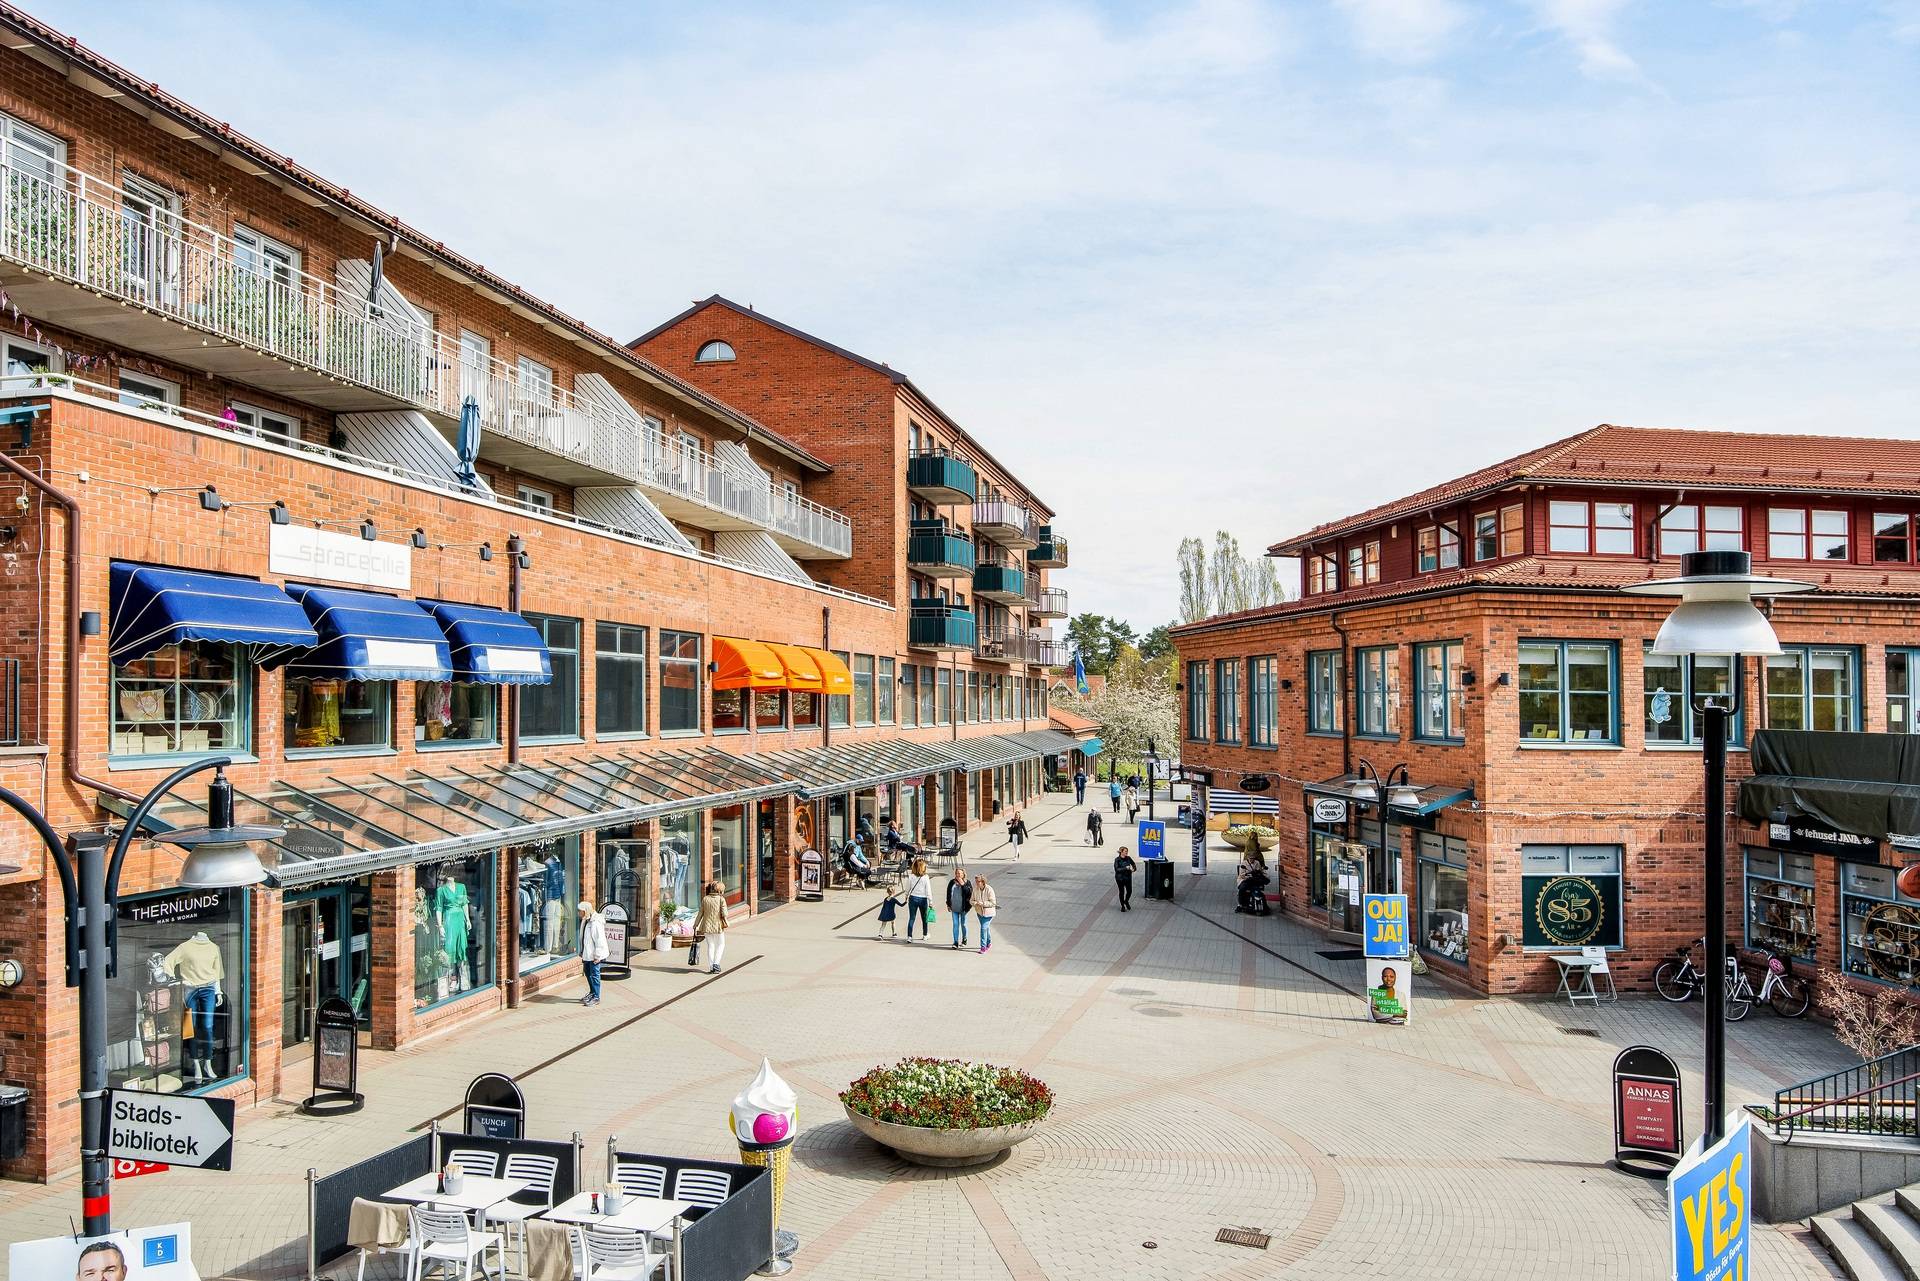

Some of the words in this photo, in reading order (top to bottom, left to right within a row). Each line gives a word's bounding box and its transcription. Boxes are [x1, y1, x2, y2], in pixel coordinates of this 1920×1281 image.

[300, 545, 405, 575] saracecilia
[1142, 828, 1161, 841] JA!
[1804, 828, 1837, 841] tehuset
[1838, 832, 1862, 845] JAVA
[132, 894, 219, 921] THERNLUNDS
[177, 913, 198, 921] WOMAN
[1368, 899, 1402, 920] OUI
[1547, 898, 1592, 923] 85
[1372, 923, 1403, 943] JA!
[1369, 989, 1386, 997] Hopp
[1627, 1086, 1670, 1100] ANNAS
[114, 1100, 182, 1125] Stads-
[481, 1117, 506, 1127] LUNCH
[112, 1128, 199, 1156] bibliotek
[1636, 1134, 1664, 1142] SKRÄDDERI
[1681, 1151, 1744, 1275] YES
[1705, 1265, 1721, 1281] Rösta
[1721, 1255, 1729, 1269] för
